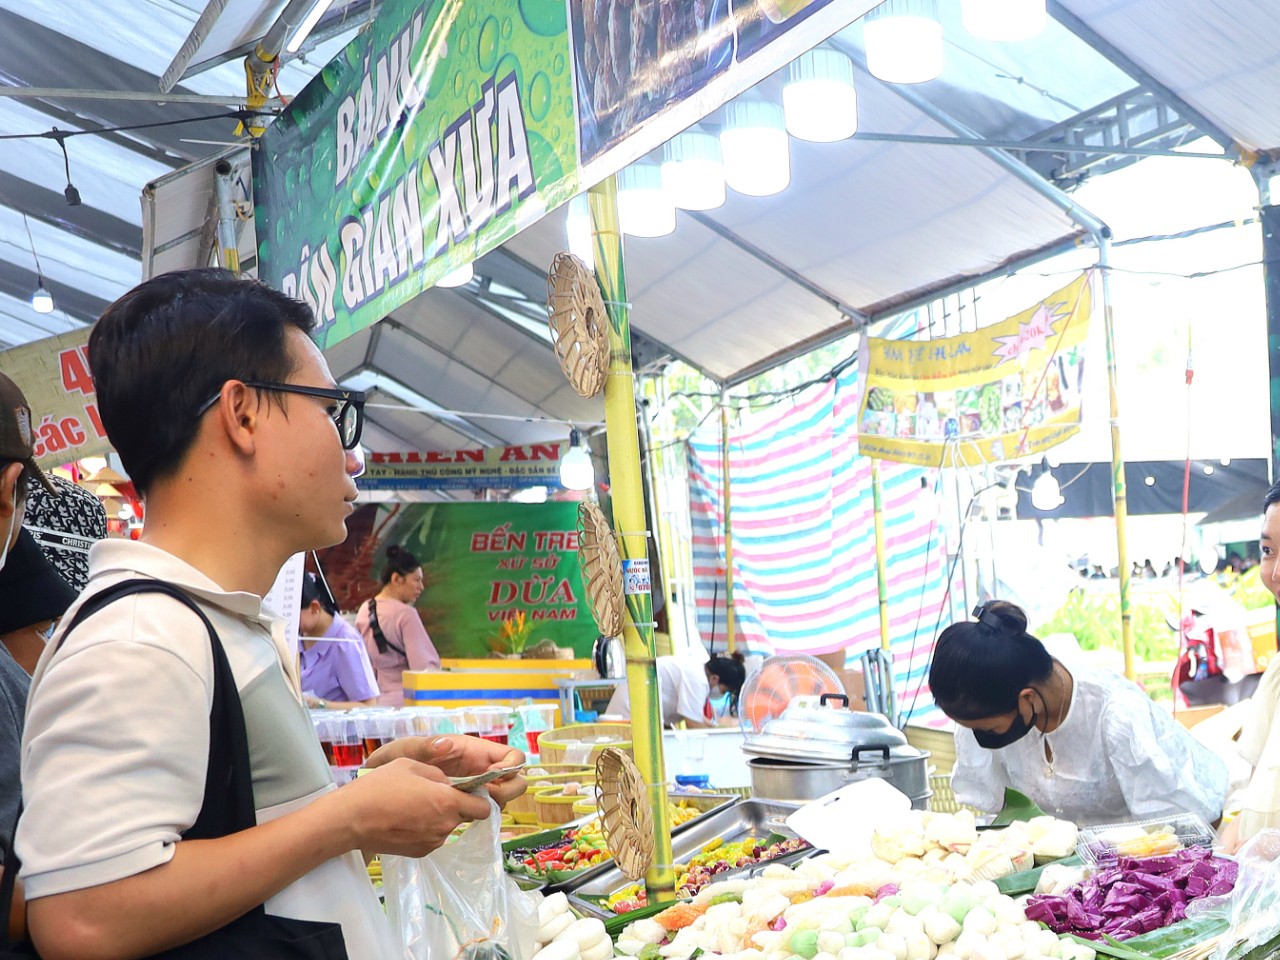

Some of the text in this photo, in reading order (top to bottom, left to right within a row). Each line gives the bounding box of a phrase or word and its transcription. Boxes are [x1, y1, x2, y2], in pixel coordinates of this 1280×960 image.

[341, 161, 424, 308] GIAN
[429, 79, 533, 245] XƯA
[471, 523, 579, 551] BẾN TRE
[487, 573, 577, 605] DỪA
[532, 607, 577, 621] NAM
